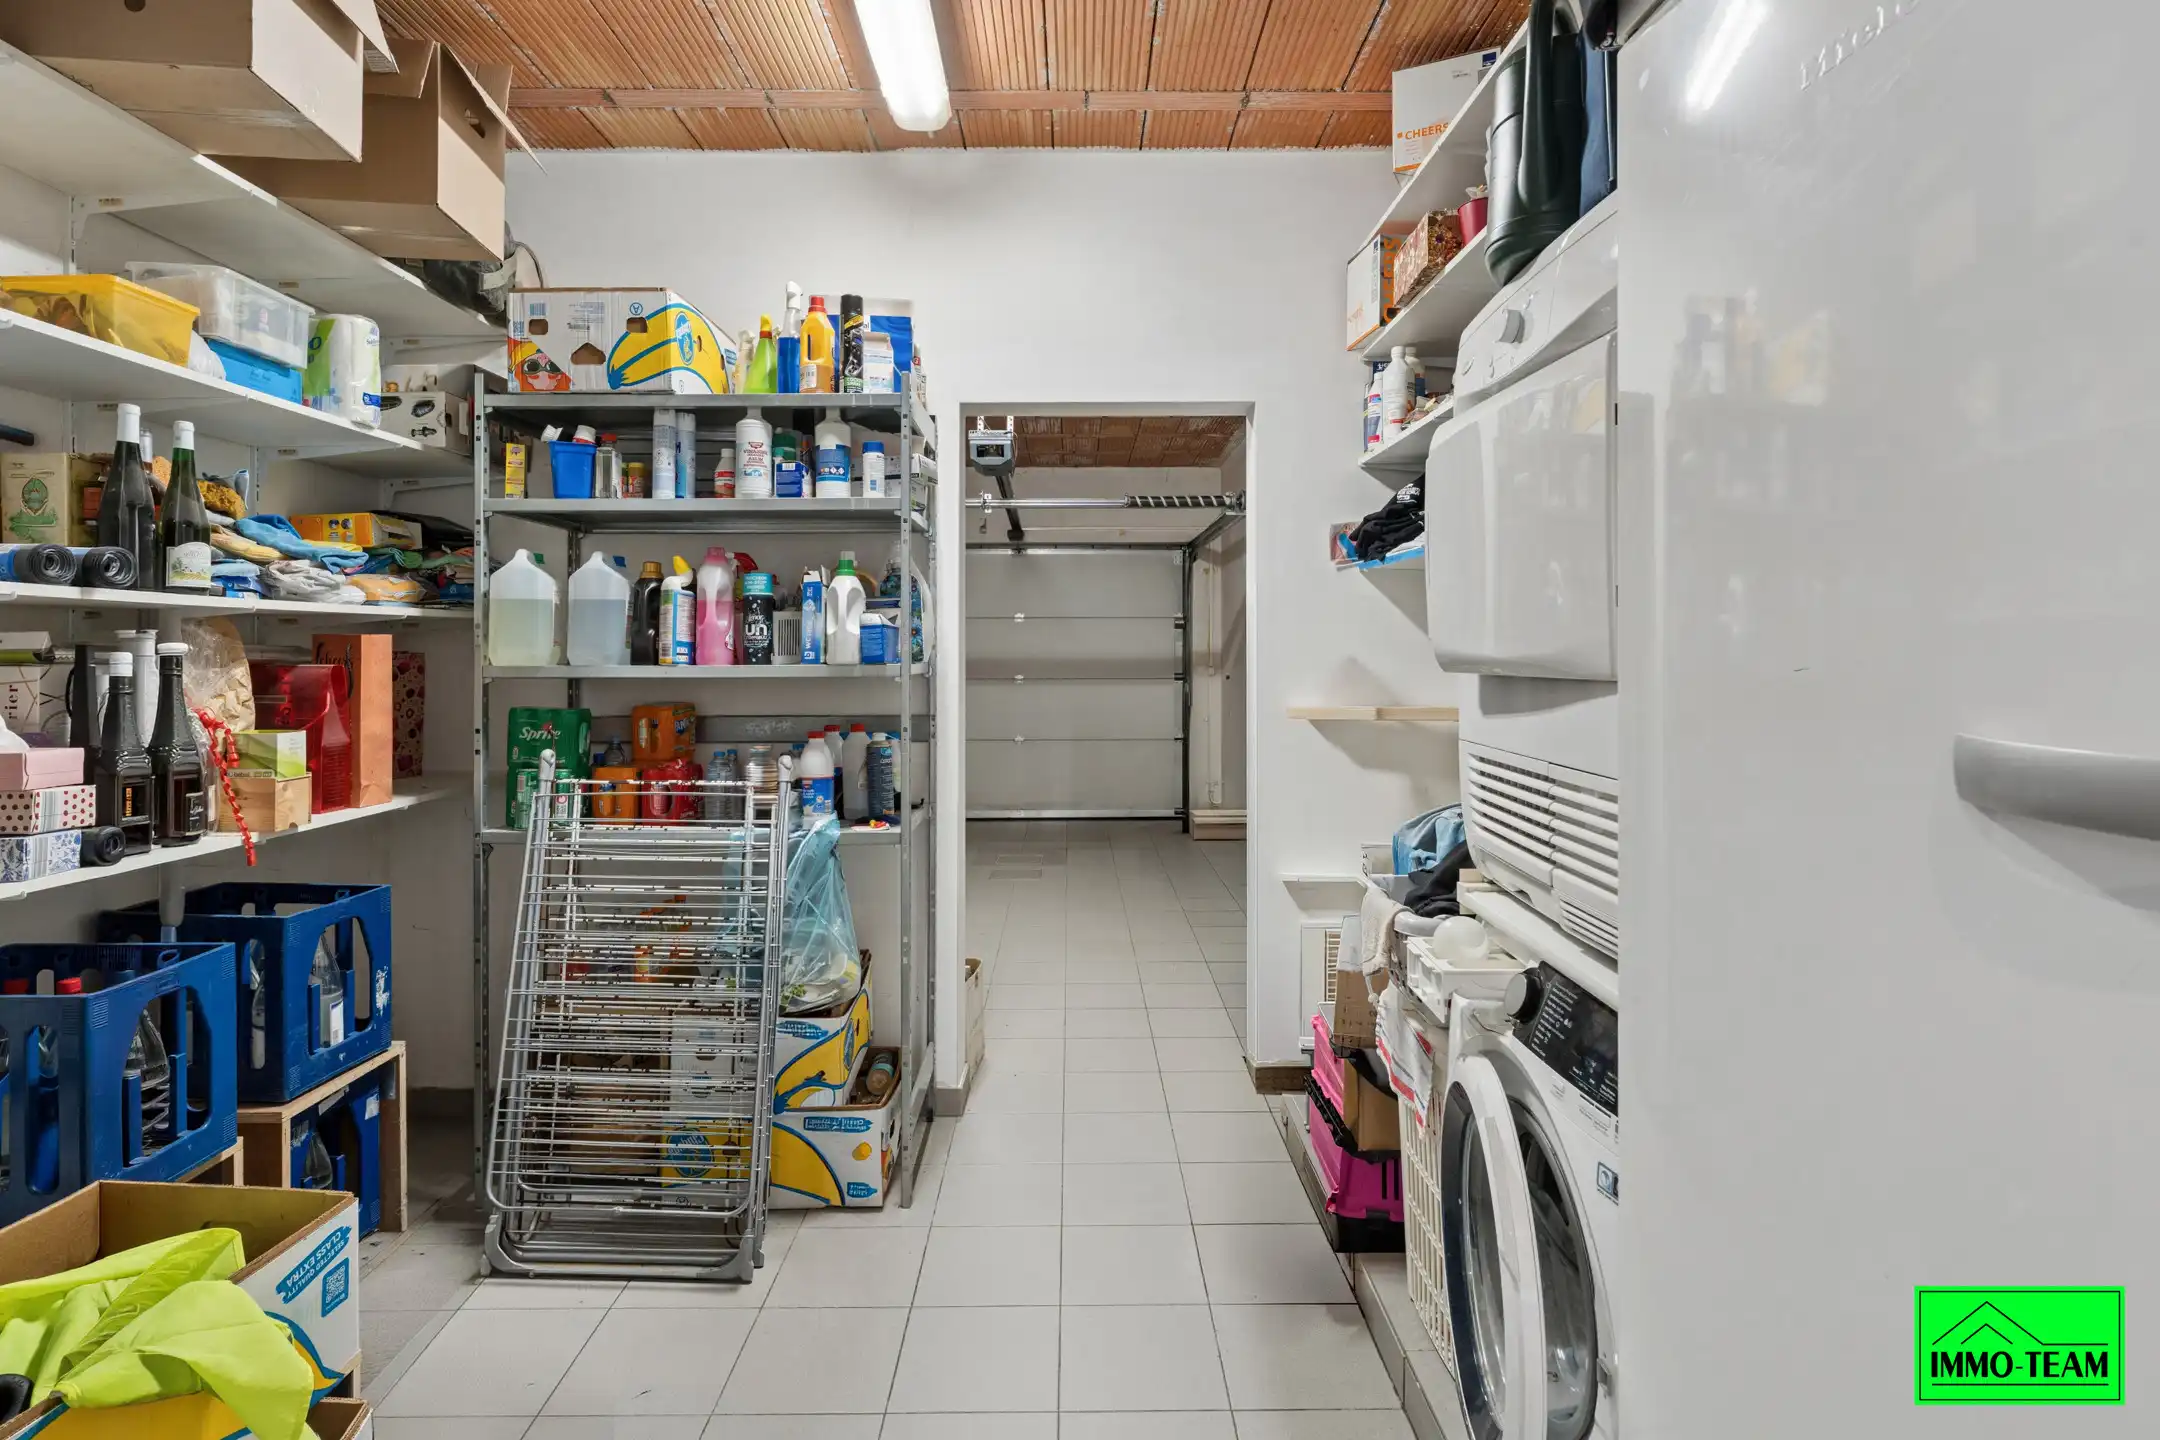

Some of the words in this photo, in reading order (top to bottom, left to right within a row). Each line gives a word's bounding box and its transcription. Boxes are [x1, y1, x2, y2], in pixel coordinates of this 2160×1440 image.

[519, 726, 561, 741] Sprie
[315, 1231, 342, 1260] CLASS
[315, 1239, 345, 1271] SELECTED
[286, 1256, 315, 1287] EXTRA
[287, 1268, 315, 1299] QUALITY
